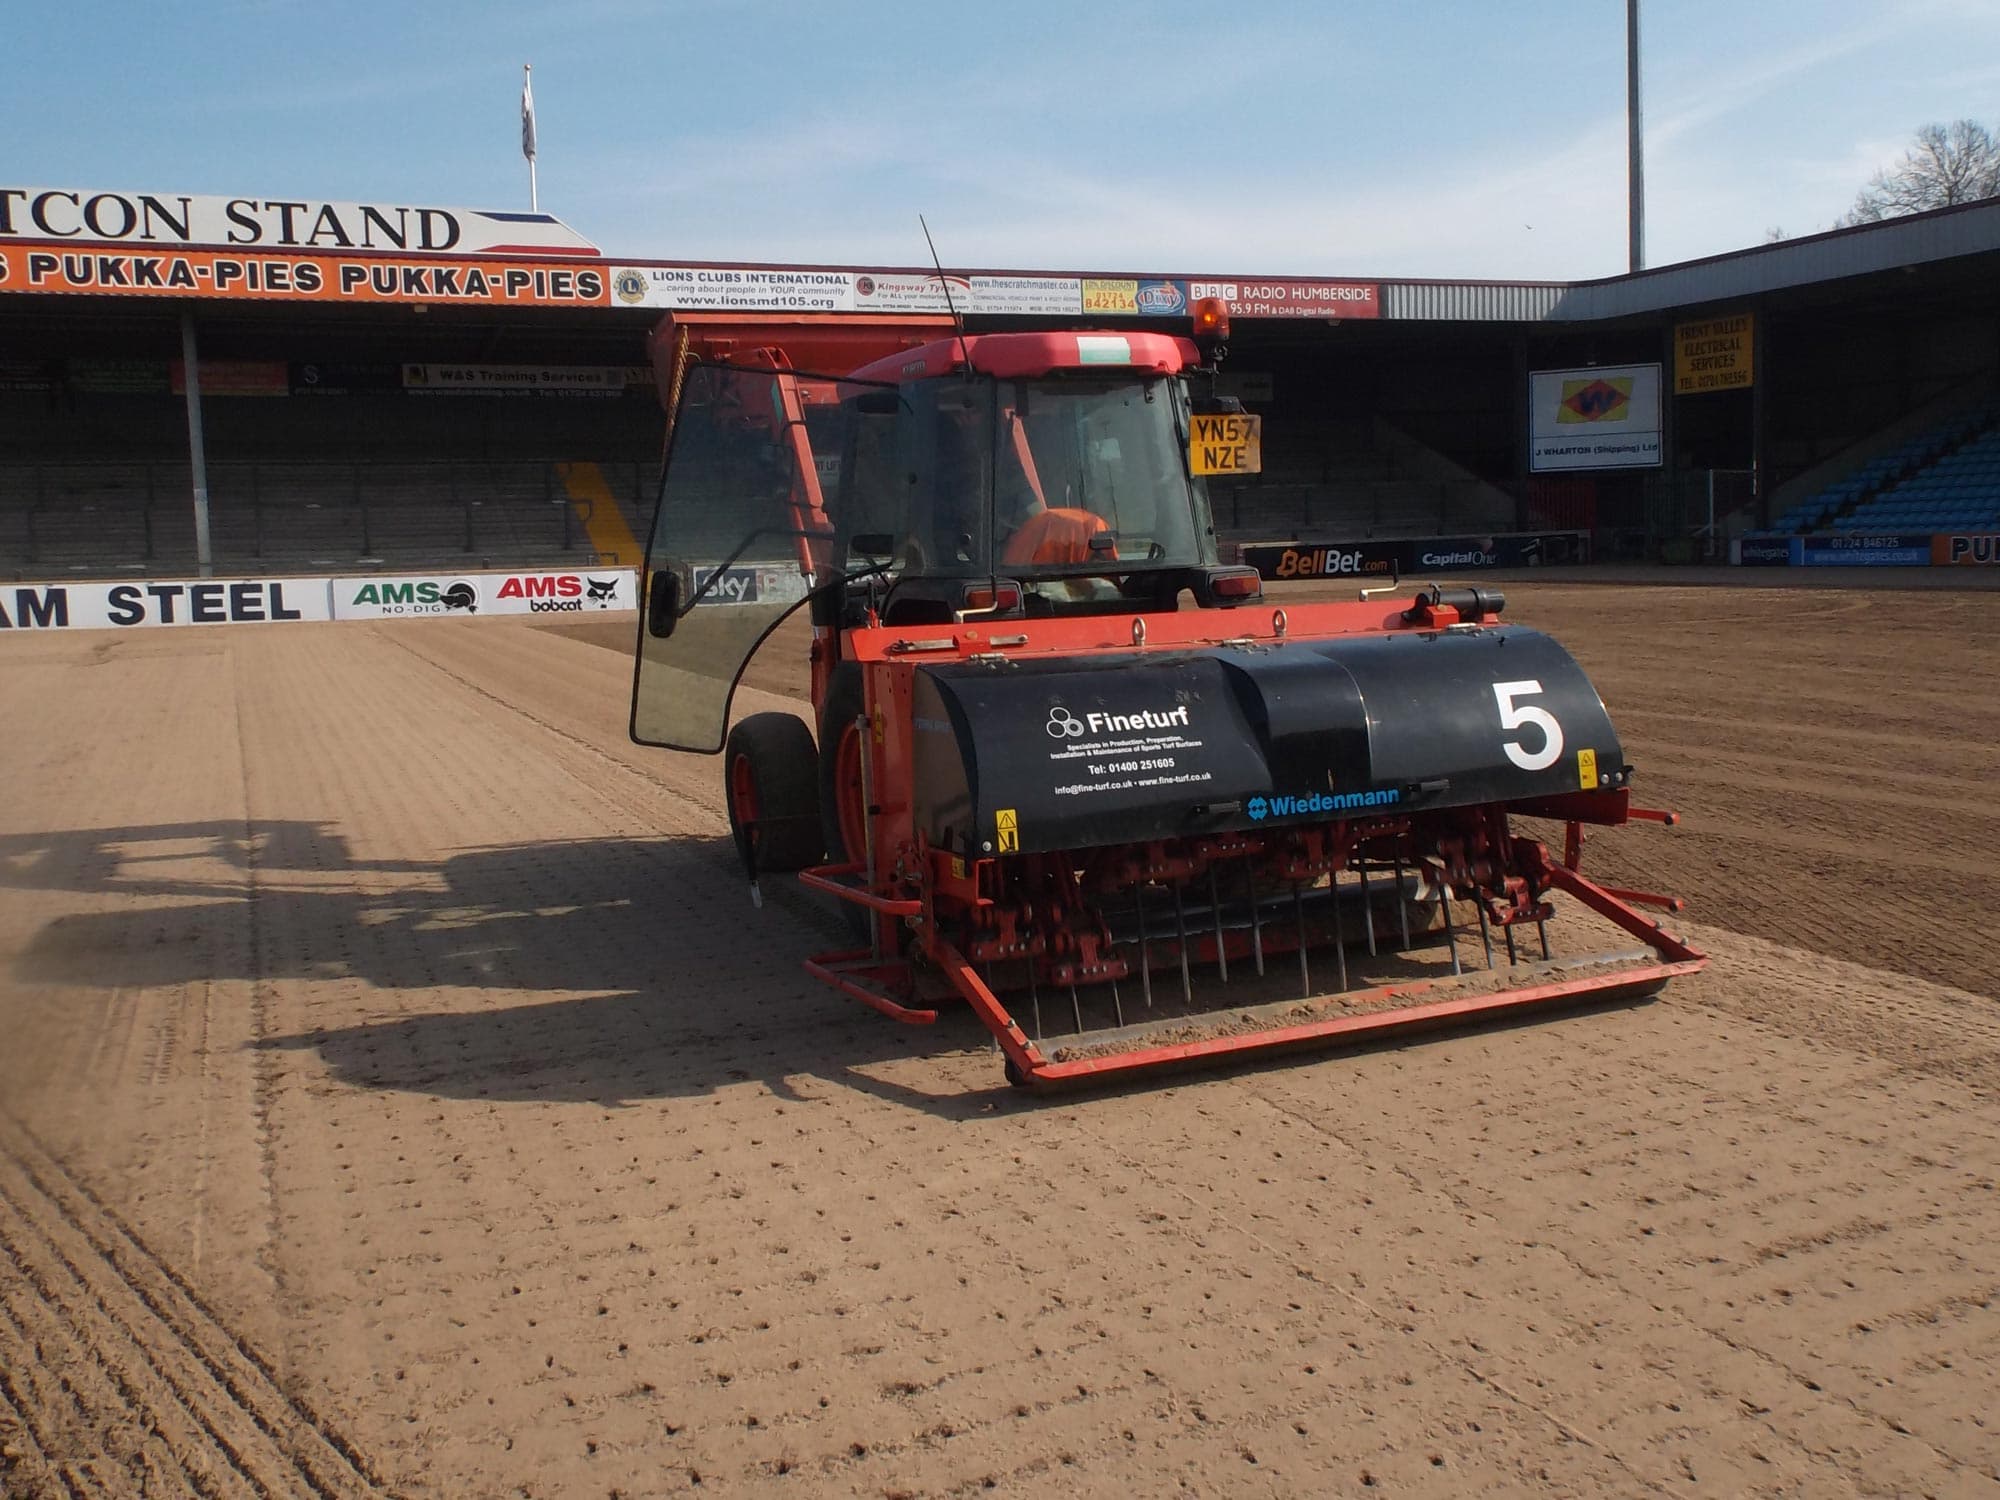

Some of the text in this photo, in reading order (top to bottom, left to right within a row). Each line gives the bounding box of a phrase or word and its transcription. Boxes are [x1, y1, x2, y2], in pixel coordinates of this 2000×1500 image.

[0, 189, 461, 251] TCON STAND
[28, 252, 322, 295] PUKKA-PIES
[339, 264, 602, 300] PUKKA-PIES
[652, 271, 850, 285] LIONS CLUBS INTERNATIONAL
[697, 284, 724, 294] about
[726, 285, 757, 296] people
[758, 286, 768, 294] in
[769, 286, 796, 295] YOUR
[797, 286, 846, 297] community
[877, 282, 926, 293] Kingsway
[929, 284, 956, 293] Tyres
[971, 279, 1080, 290] www.thescratchmaster.co.uk
[1191, 284, 1371, 300] BBC RADIO HUMBERSIDE
[676, 296, 835, 309] www.lionsmd105.org
[1085, 298, 1135, 309] 842134
[1230, 303, 1252, 314] 95.9
[1254, 303, 1270, 314] FM
[1296, 307, 1317, 316] Digital
[479, 371, 537, 383] Training
[542, 371, 602, 382] Services
[1197, 419, 1254, 442] YN57
[1204, 446, 1247, 470] NZE
[1535, 443, 1658, 457] J WHARTON (Shipping) Ltd
[353, 582, 441, 605] AMS
[496, 575, 582, 599] AMS
[107, 582, 302, 626] STEEL
[382, 604, 442, 614] NO-DIG
[530, 598, 583, 613] bobcat
[1086, 706, 1190, 734] Fineturf
[1492, 680, 1564, 771] 5
[1088, 758, 1175, 775] Tel: 01400 251605
[1055, 772, 1212, 795] info@fine-turf.co.uk www.fine-turf.co.uk
[1269, 787, 1400, 817] Wiedenmann
